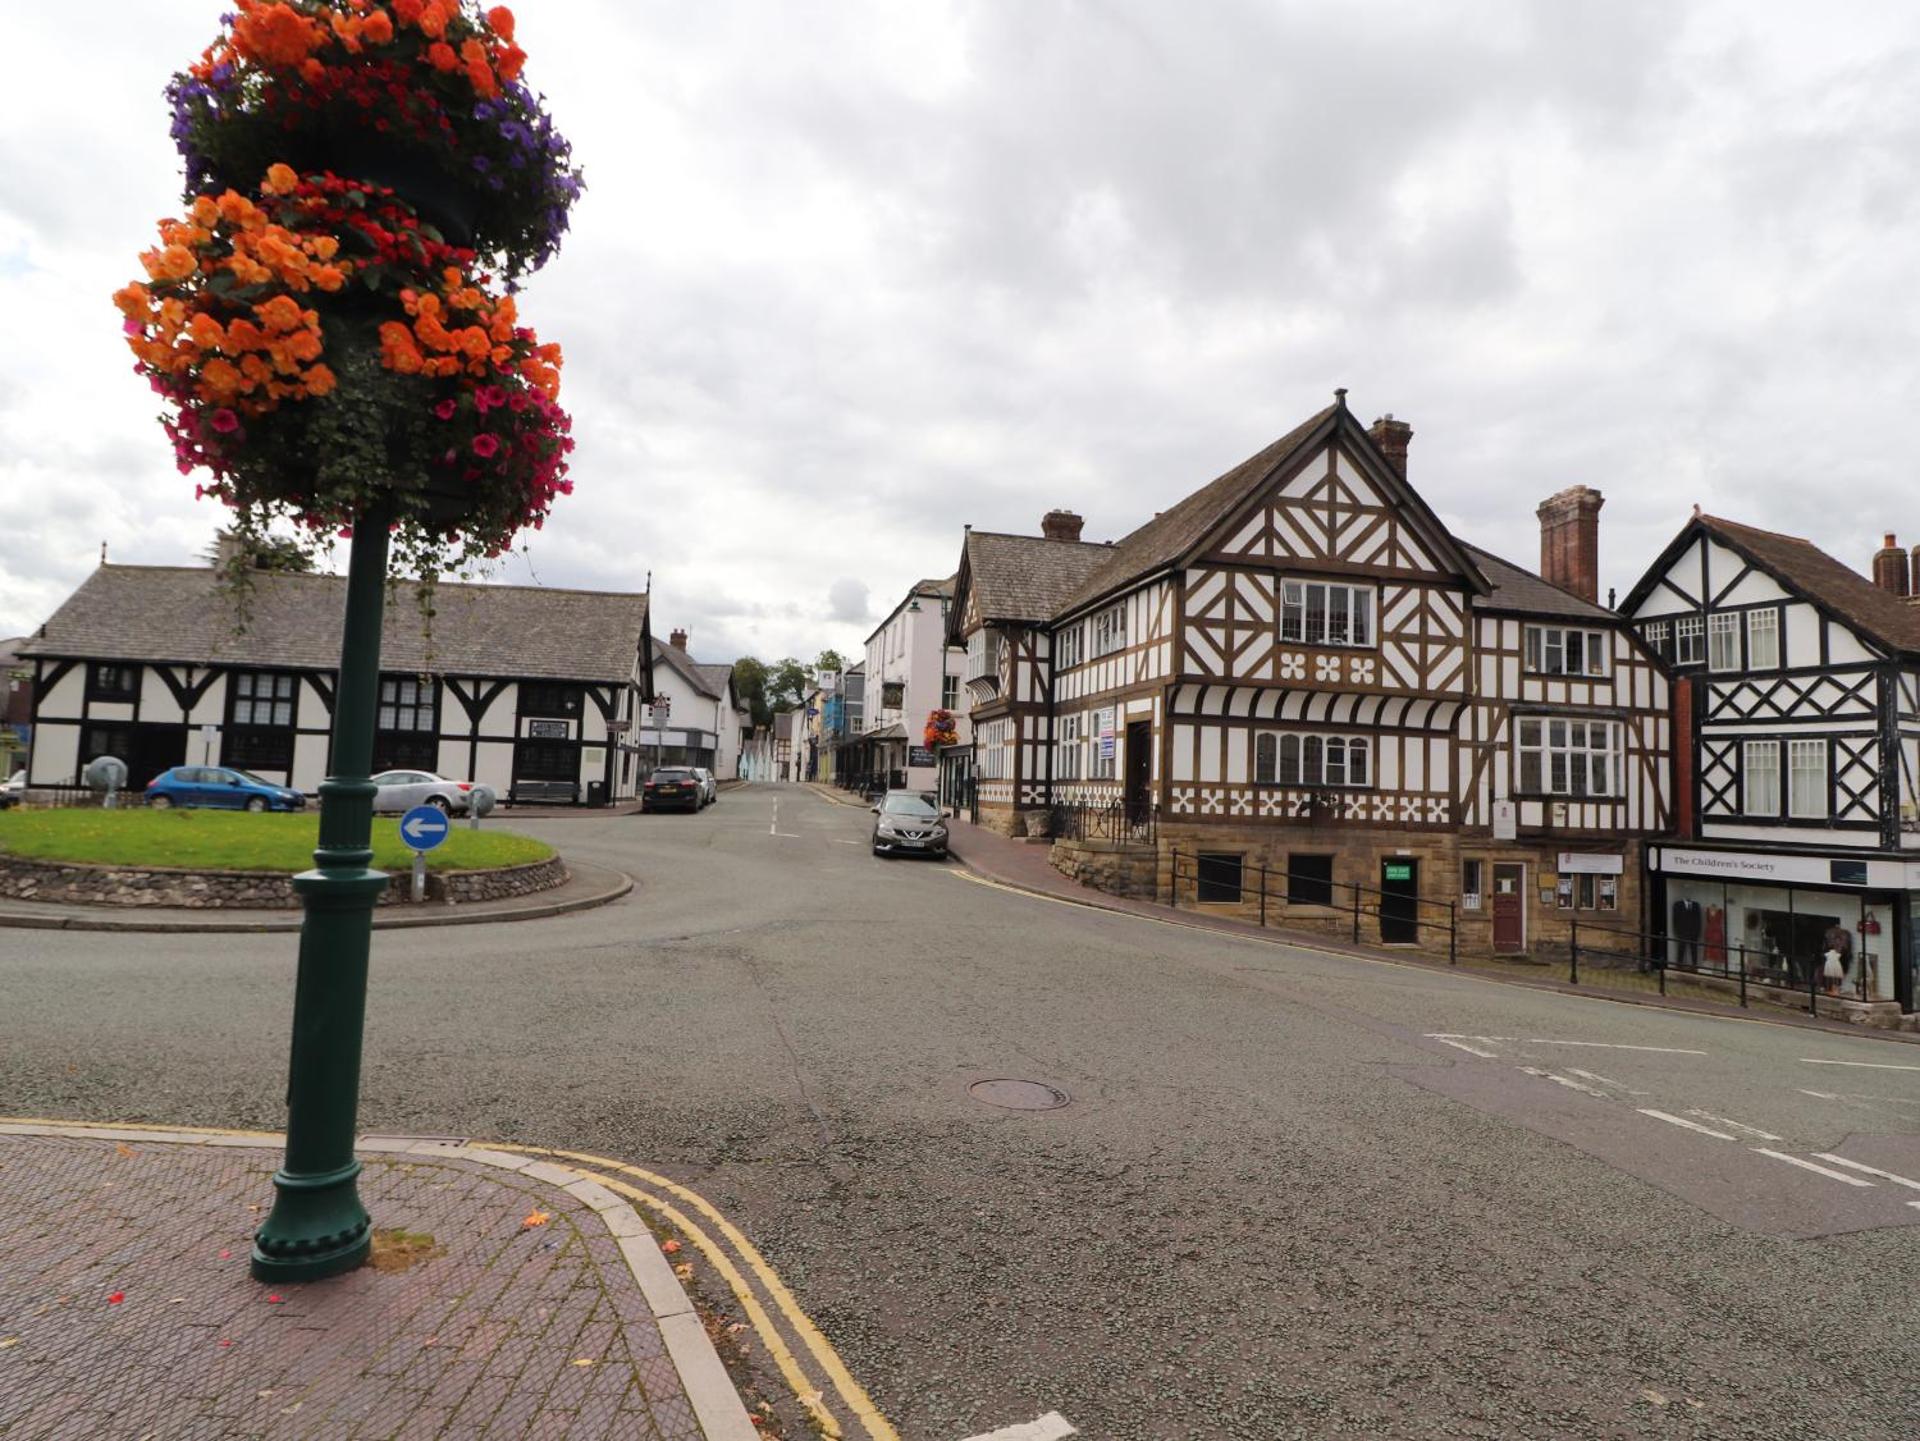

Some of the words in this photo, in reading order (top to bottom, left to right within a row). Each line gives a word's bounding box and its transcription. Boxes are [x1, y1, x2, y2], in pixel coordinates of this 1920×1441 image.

[1674, 857, 1690, 865] The
[1692, 858, 1738, 868] Children's
[1740, 861, 1775, 872] Society
